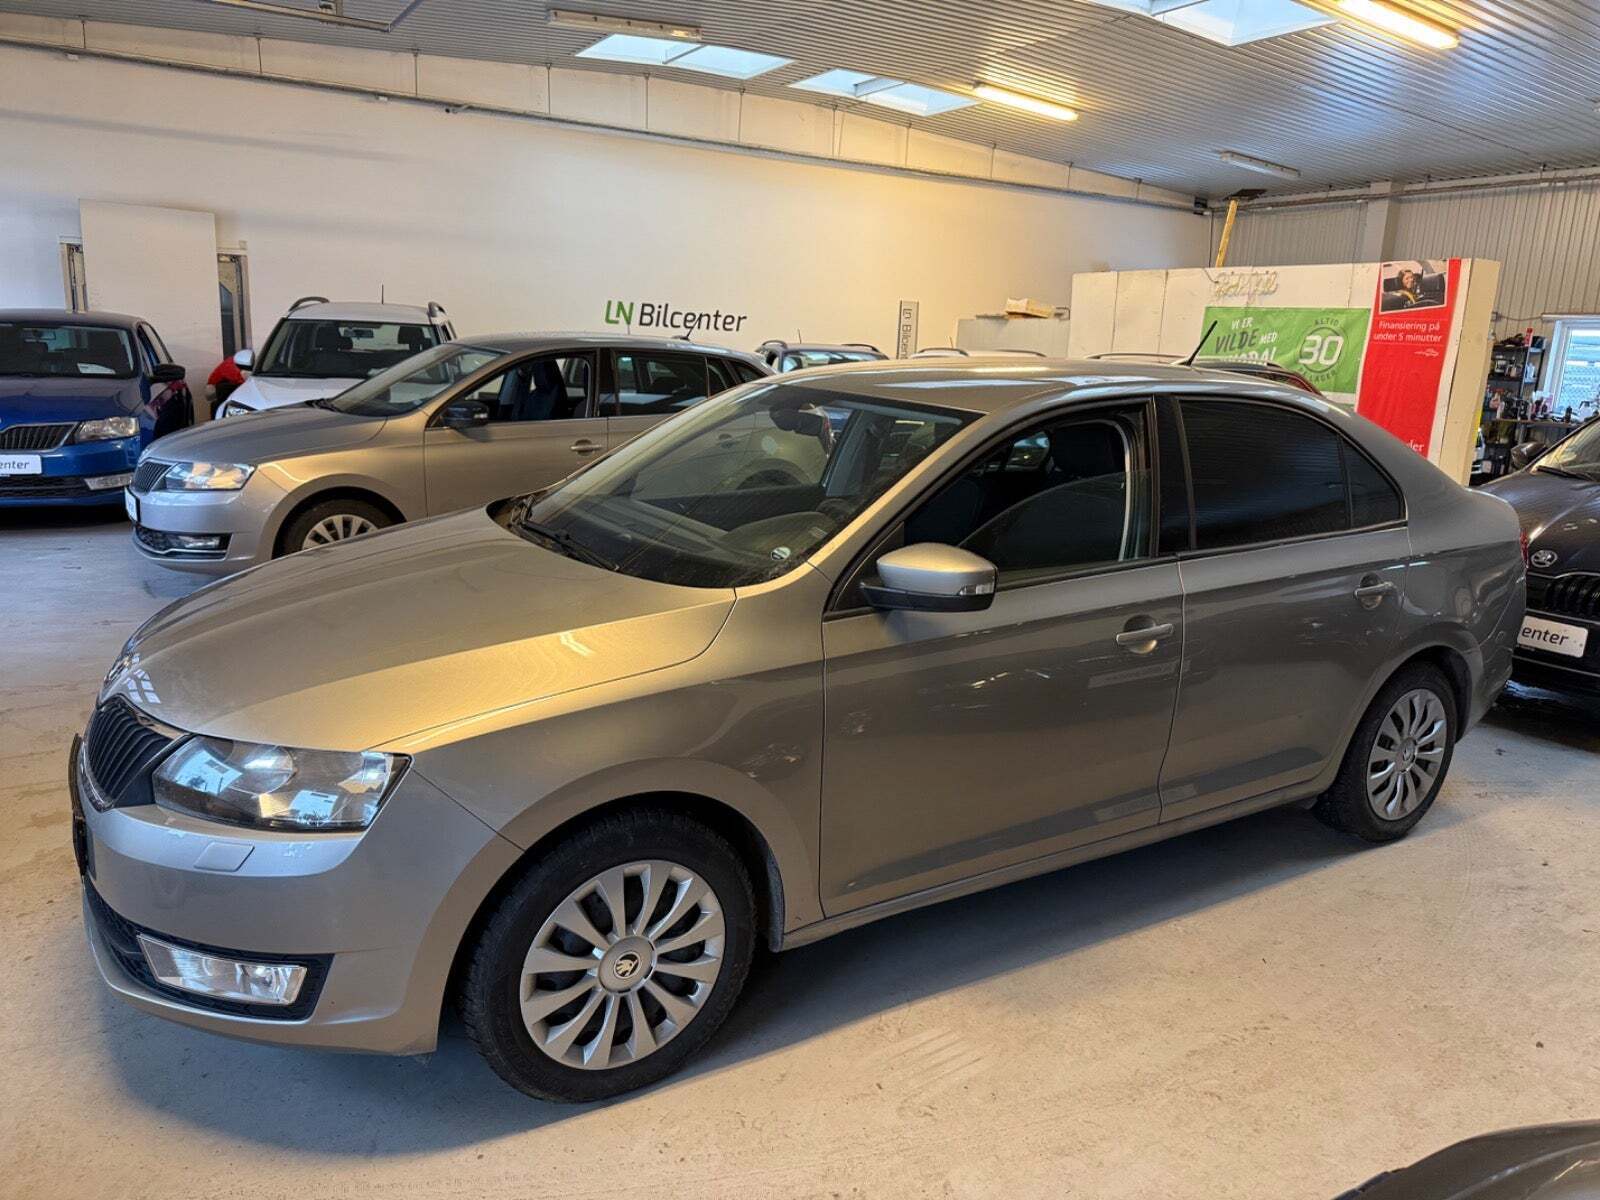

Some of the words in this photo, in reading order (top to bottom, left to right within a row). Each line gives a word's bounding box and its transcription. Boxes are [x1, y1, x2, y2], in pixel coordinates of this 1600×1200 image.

[604, 300, 634, 325] LN
[639, 303, 747, 331] Bilcenter
[1378, 320, 1427, 333] Finansiering
[1428, 320, 1441, 333] på
[1215, 327, 1260, 354] VILDE
[1260, 331, 1278, 345] MED
[1373, 332, 1397, 341] under
[1397, 332, 1405, 342] 5
[1405, 333, 1442, 344] minutter
[1298, 334, 1345, 366] 30
[1521, 626, 1569, 646] enter
